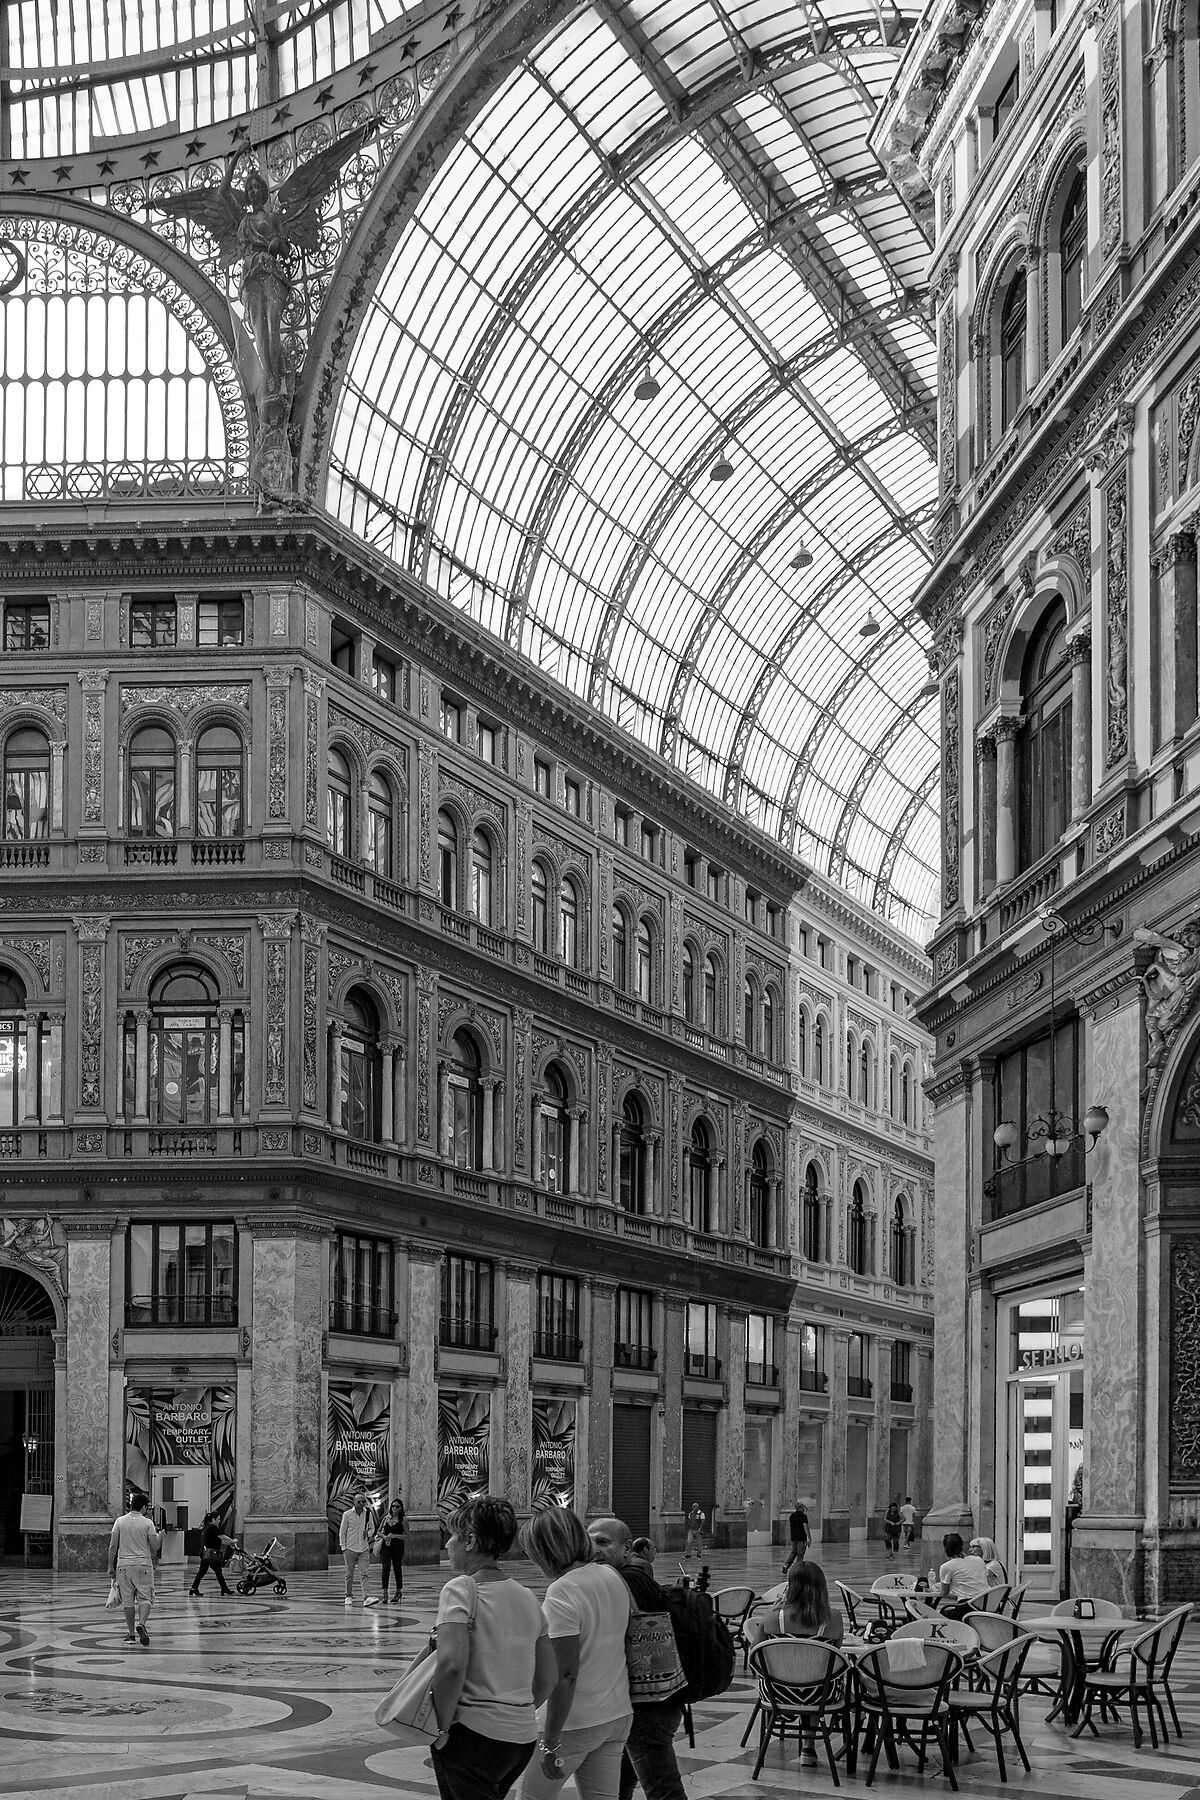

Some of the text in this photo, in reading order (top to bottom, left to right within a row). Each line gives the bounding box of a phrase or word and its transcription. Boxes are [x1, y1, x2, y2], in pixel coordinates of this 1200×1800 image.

[1023, 1343, 1081, 1369] SEPHO
[156, 1413, 208, 1421] BARBARO
[336, 1441, 376, 1451] BARBARO
[444, 1445, 478, 1455] BARBARO
[536, 1450, 565, 1458] BARBARO
[929, 1622, 948, 1638] K
